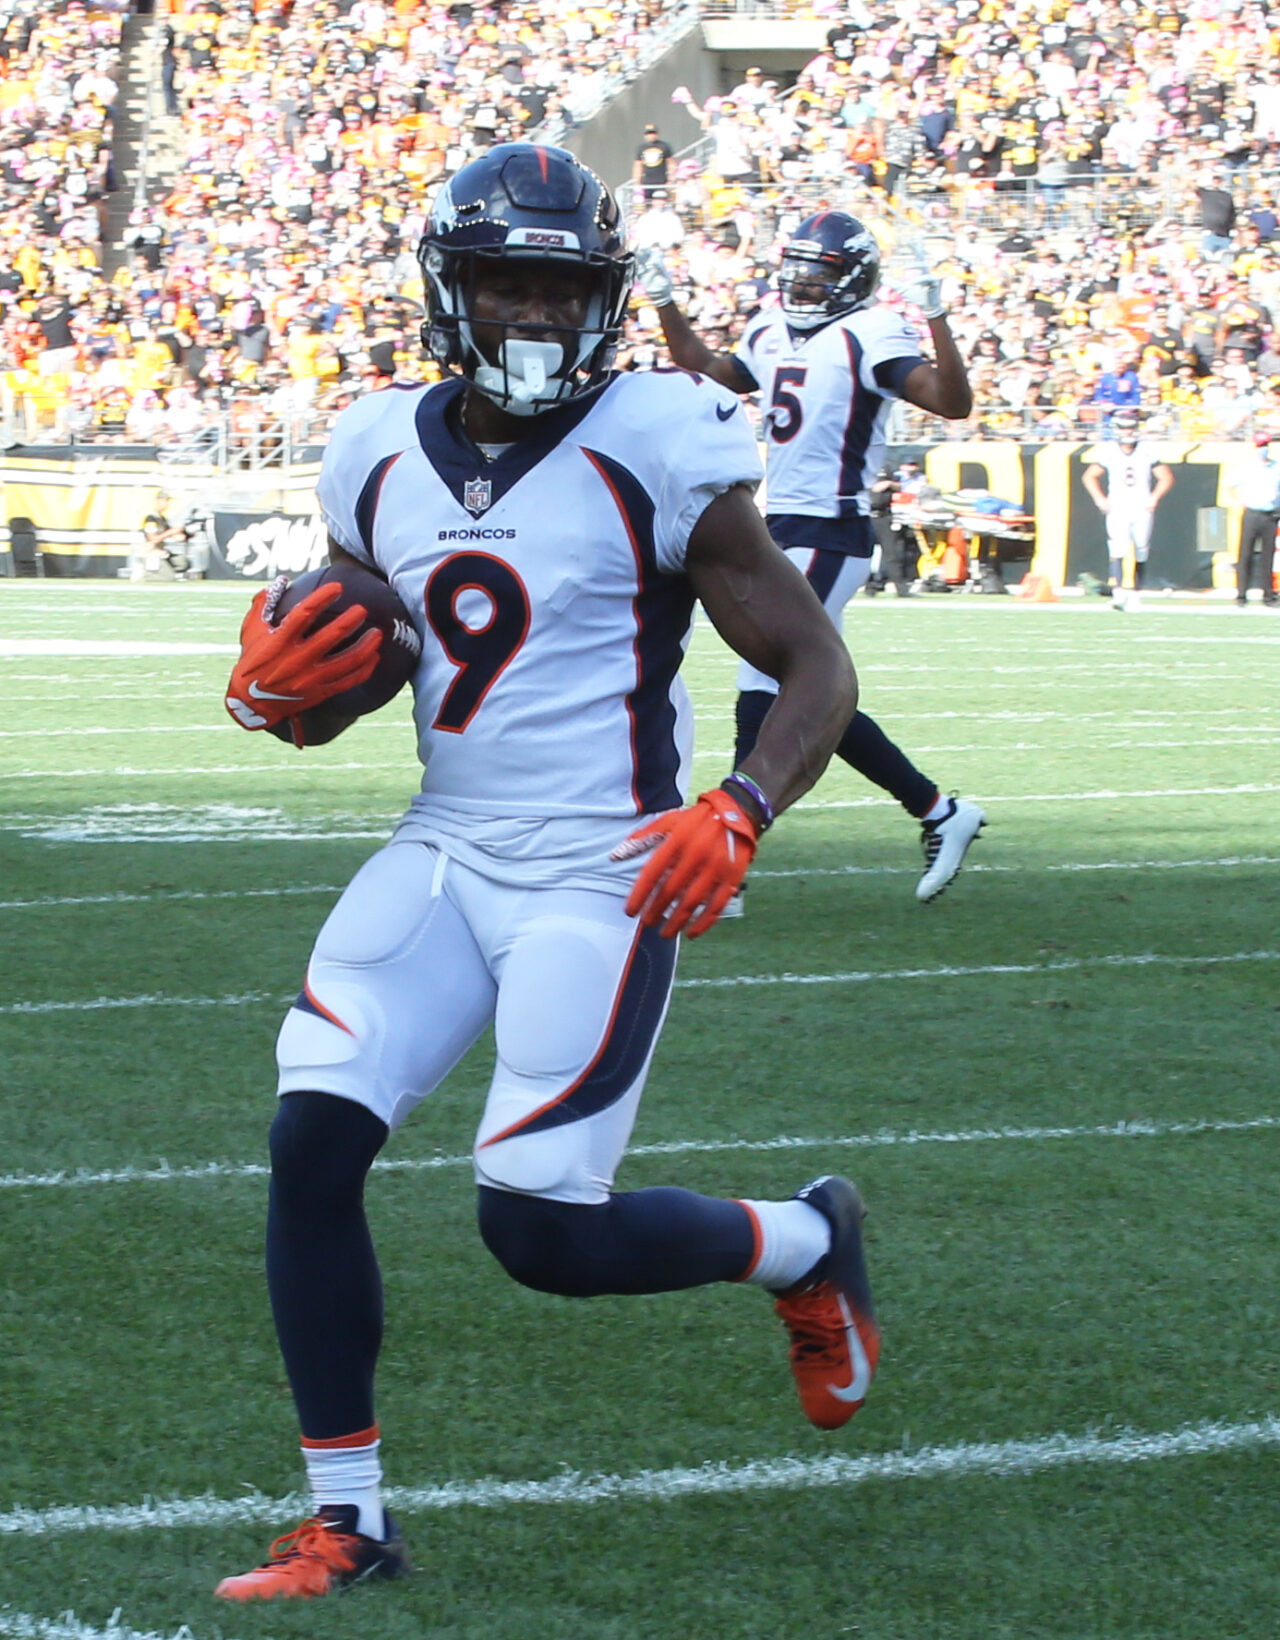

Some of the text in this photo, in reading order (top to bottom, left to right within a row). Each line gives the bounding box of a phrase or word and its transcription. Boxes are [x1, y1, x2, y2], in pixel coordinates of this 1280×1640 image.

[770, 366, 809, 445] 5
[467, 492, 488, 507] NFL
[437, 528, 516, 541] BRONCOS
[423, 550, 532, 735] 9
